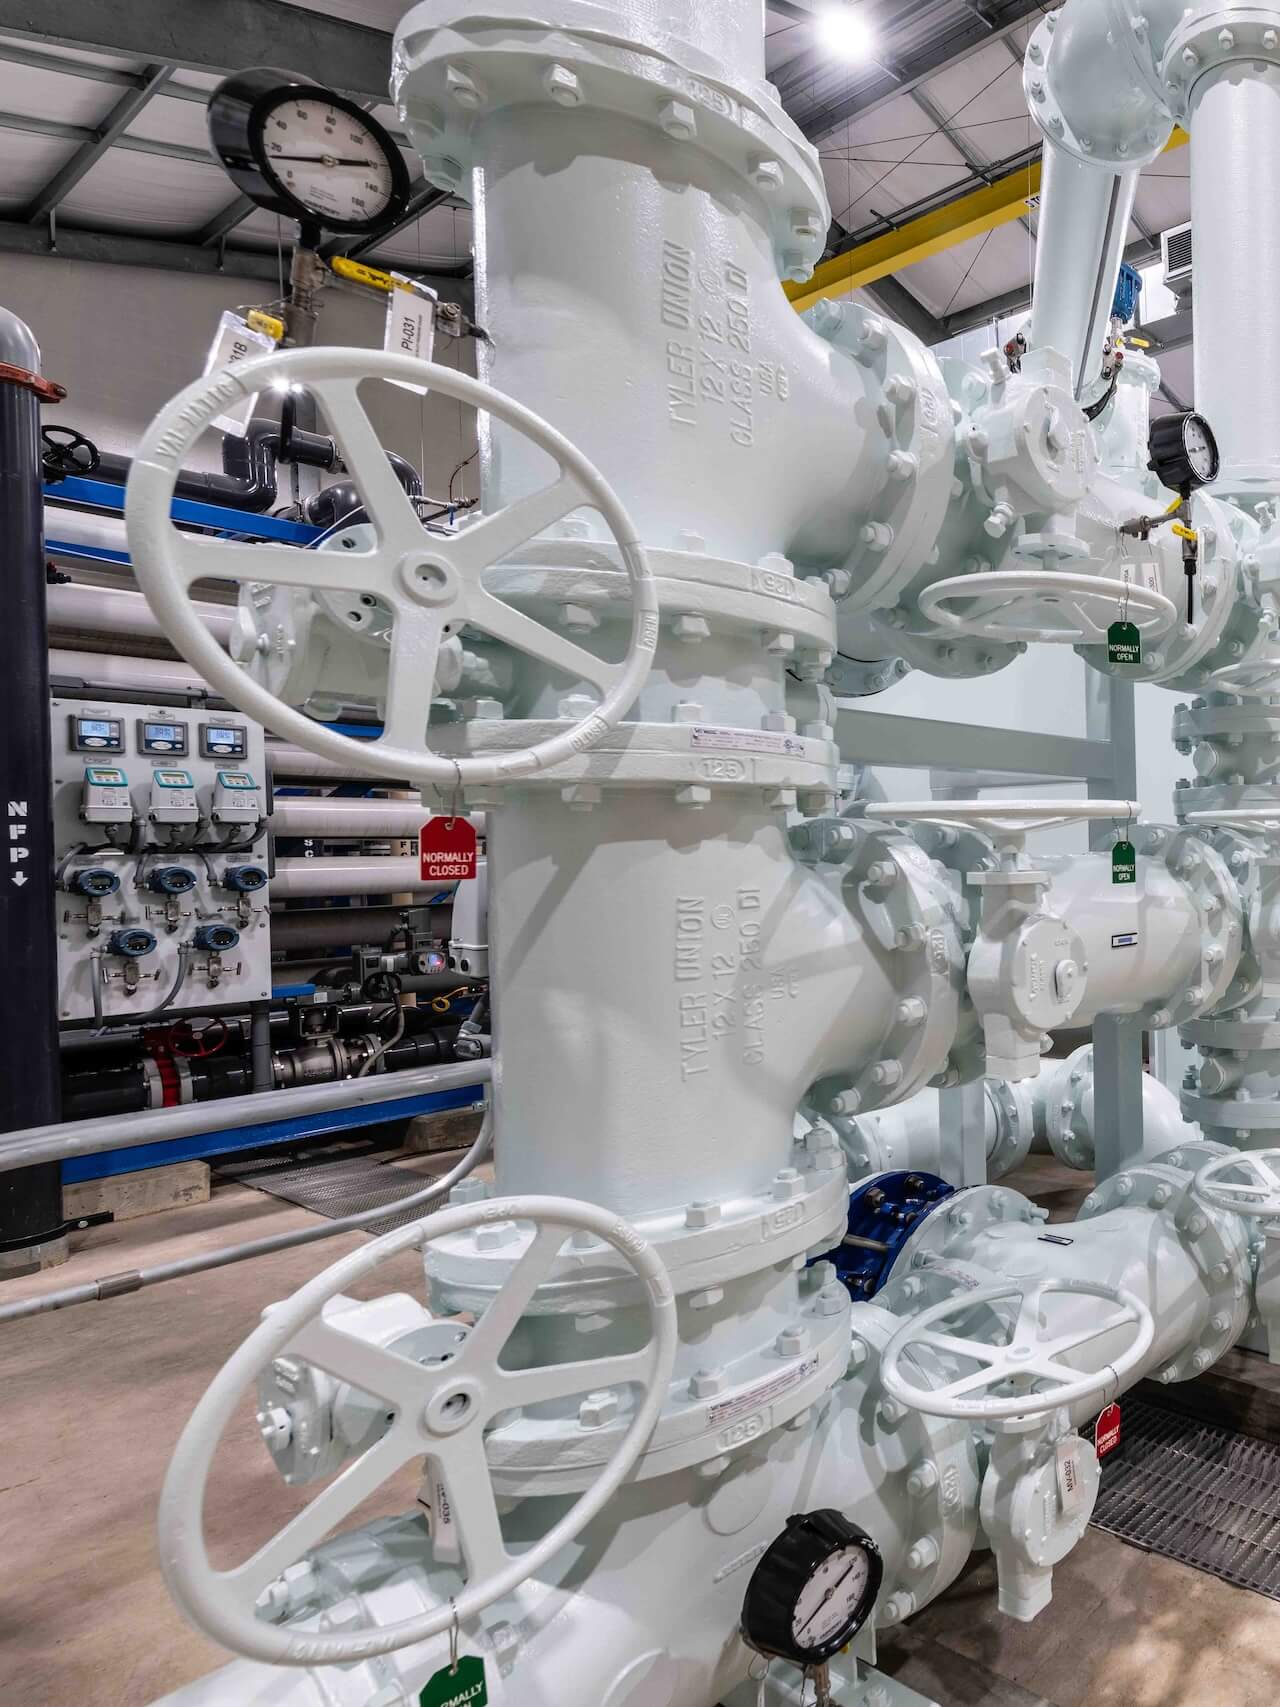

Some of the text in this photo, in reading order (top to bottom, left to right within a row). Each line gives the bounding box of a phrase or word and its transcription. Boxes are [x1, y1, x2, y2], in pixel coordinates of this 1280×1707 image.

[401, 317, 416, 352] PI-031
[662, 239, 697, 425] TYLER UNION
[726, 299, 752, 354] 250
[700, 311, 727, 404] 12 X 12
[729, 359, 754, 448] CLASS
[1109, 644, 1139, 653] NORMALLY
[1116, 653, 1134, 661] OPEN
[703, 761, 737, 778] 125
[422, 851, 474, 864] NORMALLY
[429, 864, 469, 877] CLOSED
[1112, 864, 1136, 873] NORMALLY
[1118, 872, 1130, 881] OPEN
[673, 896, 710, 1083] TYLER UNION
[736, 888, 765, 1066] CLASS 250 DI
[711, 951, 737, 1041] 12 X 12
[1097, 1424, 1120, 1447] NORMALLY
[1099, 1436, 1118, 1454] CLOSED
[1063, 1459, 1075, 1492] MV-032
